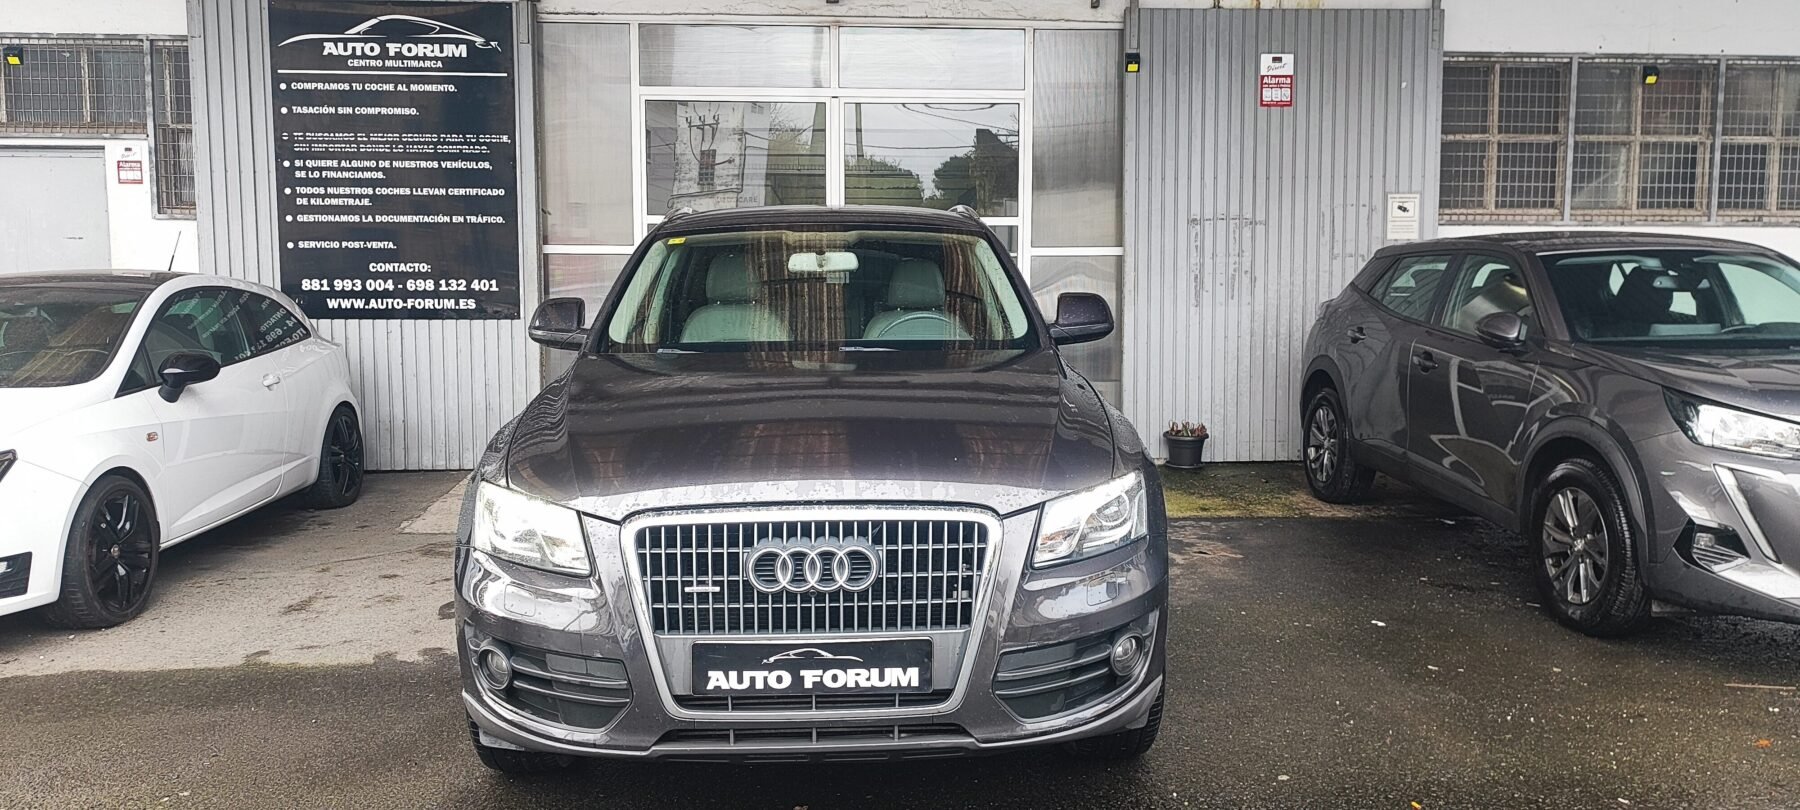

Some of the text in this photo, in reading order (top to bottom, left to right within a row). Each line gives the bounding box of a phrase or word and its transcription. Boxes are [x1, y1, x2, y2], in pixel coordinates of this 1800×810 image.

[323, 42, 467, 57] AUTO FORUM
[292, 105, 335, 113] TASACIÓN
[441, 160, 492, 170] VEHÍCULOS,
[376, 214, 450, 222] DOCUMENTACIÓN
[466, 214, 505, 223] TRÁFICO.
[369, 263, 431, 272] CONTACTO:
[302, 279, 330, 290] 881
[334, 279, 362, 291] 993
[366, 279, 394, 291] 004
[407, 279, 434, 291] 698
[439, 279, 466, 290] 132
[471, 279, 499, 291] 401
[327, 299, 476, 309] WWW.AUTO-FORUM.ES
[706, 667, 918, 689] AUTO FORUM
